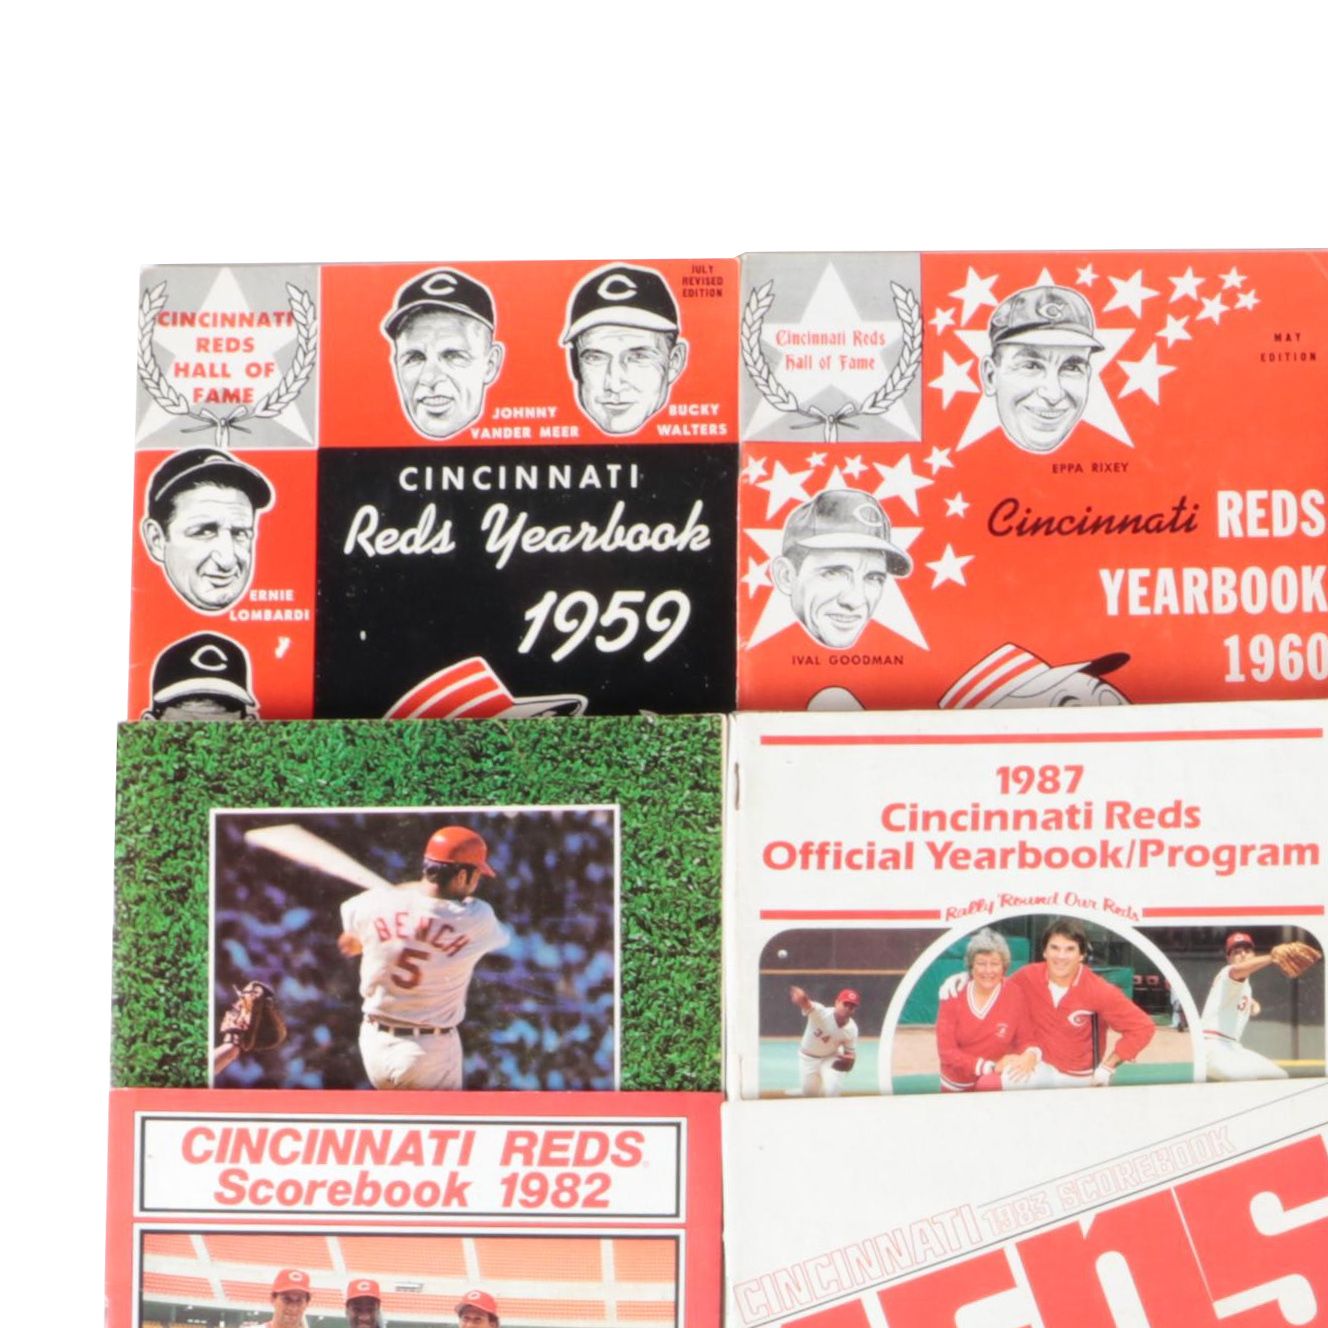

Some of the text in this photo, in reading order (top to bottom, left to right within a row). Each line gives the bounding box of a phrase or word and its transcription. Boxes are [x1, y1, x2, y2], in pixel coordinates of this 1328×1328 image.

[691, 265, 714, 273] JULY
[682, 277, 723, 285] REVISED
[682, 288, 723, 297] EDITION
[157, 310, 294, 329] CINCINNATI
[196, 336, 254, 353] REDS
[776, 329, 886, 346] Cincinnati Reds
[1273, 333, 1303, 343] MAY
[819, 355, 832, 369] of
[839, 355, 875, 371] Fame
[1260, 352, 1318, 362] EDITION
[174, 362, 275, 378] HALL OF
[192, 387, 254, 404] FAME
[492, 406, 557, 420] JOHNNY
[669, 404, 720, 416] BUCKY
[470, 426, 579, 440] VANDER MEER
[657, 424, 728, 436] WALTERS
[1052, 462, 1129, 474] EPPA RIXEY
[400, 464, 639, 491] CINCINNATI
[987, 489, 1327, 539] Cincinnati REDS
[344, 500, 711, 569] Reds Yearbook
[249, 589, 294, 602] ERNIE
[1099, 564, 1328, 616] YEARBOOK
[229, 609, 310, 622] LOMBARDI
[518, 590, 691, 663] 1959
[792, 654, 904, 666] IVAL GOODMAN
[997, 765, 1085, 795] 1987
[881, 800, 1201, 832] Cincinnati Reds
[762, 838, 1320, 876] Official Yearbook/Program
[945, 898, 994, 922] Rally
[1064, 892, 1096, 910] Our
[1103, 898, 1140, 921] Reds
[374, 912, 470, 957] BENCH
[390, 948, 432, 989] 5
[182, 1127, 645, 1168] CINCINNATI REDS
[1056, 1125, 1236, 1212] SCOREBOOK
[214, 1169, 612, 1209] Scorebook 1982
[733, 1204, 984, 1324] CINCINNATI
